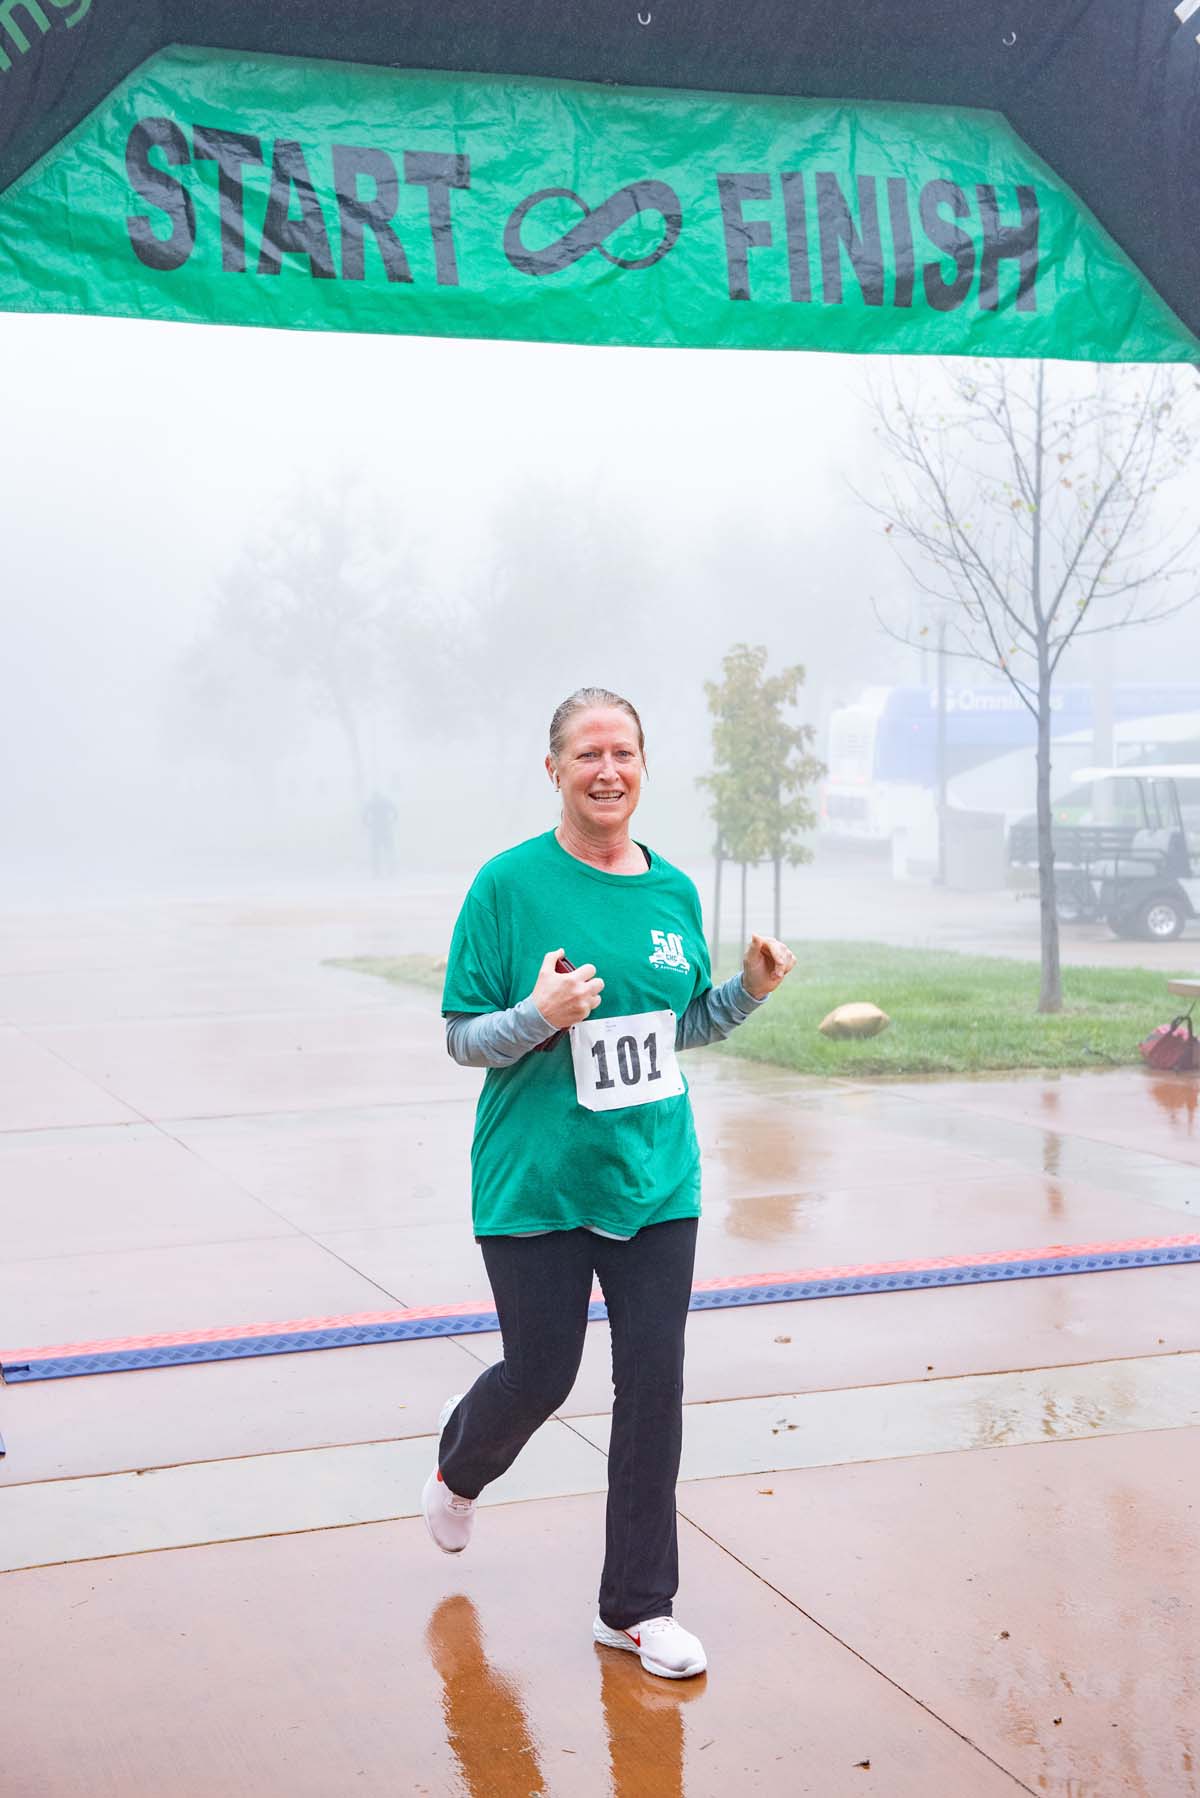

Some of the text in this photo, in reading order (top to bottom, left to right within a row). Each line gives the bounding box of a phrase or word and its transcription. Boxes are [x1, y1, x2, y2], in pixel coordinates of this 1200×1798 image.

[125, 116, 1039, 312] START FINISH
[591, 1032, 661, 1090] 101
